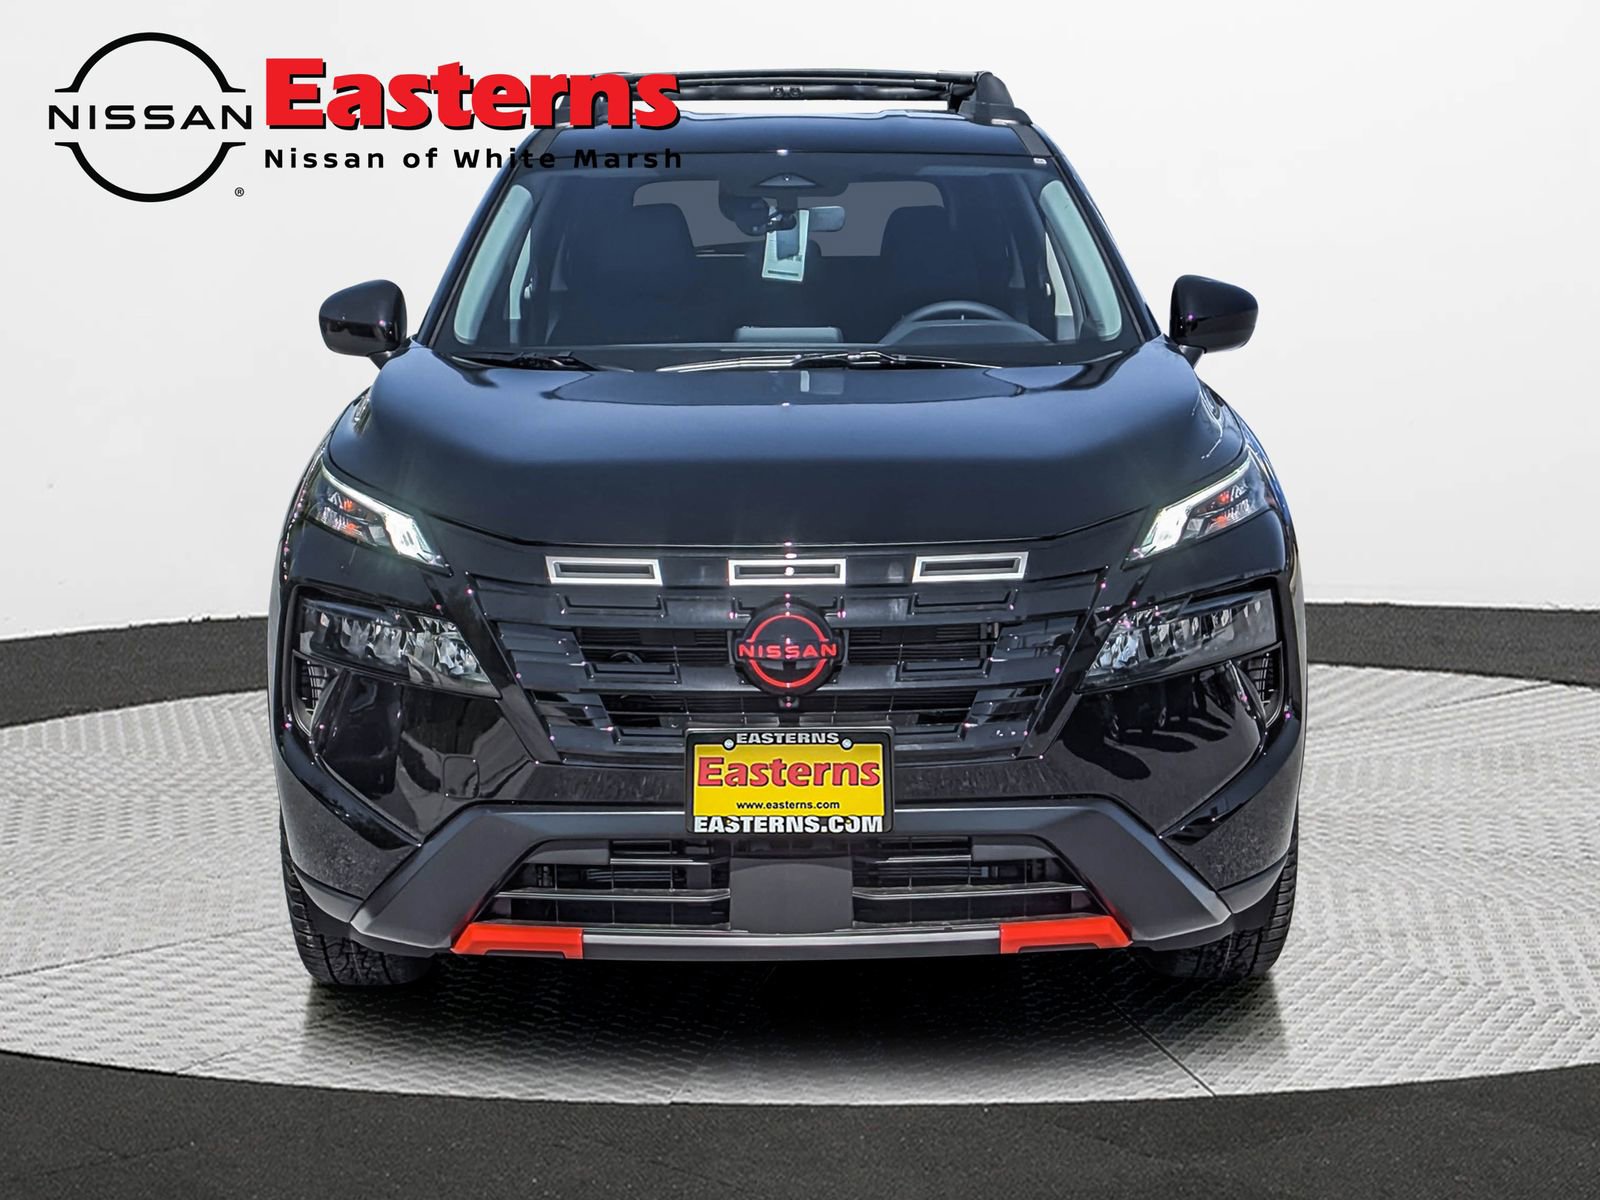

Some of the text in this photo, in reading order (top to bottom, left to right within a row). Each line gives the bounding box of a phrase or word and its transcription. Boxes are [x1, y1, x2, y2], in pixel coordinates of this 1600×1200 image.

[738, 643, 838, 658] NISSAN
[736, 733, 839, 744] EASTERNS
[697, 756, 880, 787] Easterns
[736, 801, 840, 810] www.easterns.com
[694, 816, 883, 833] EASTERNS.COM
